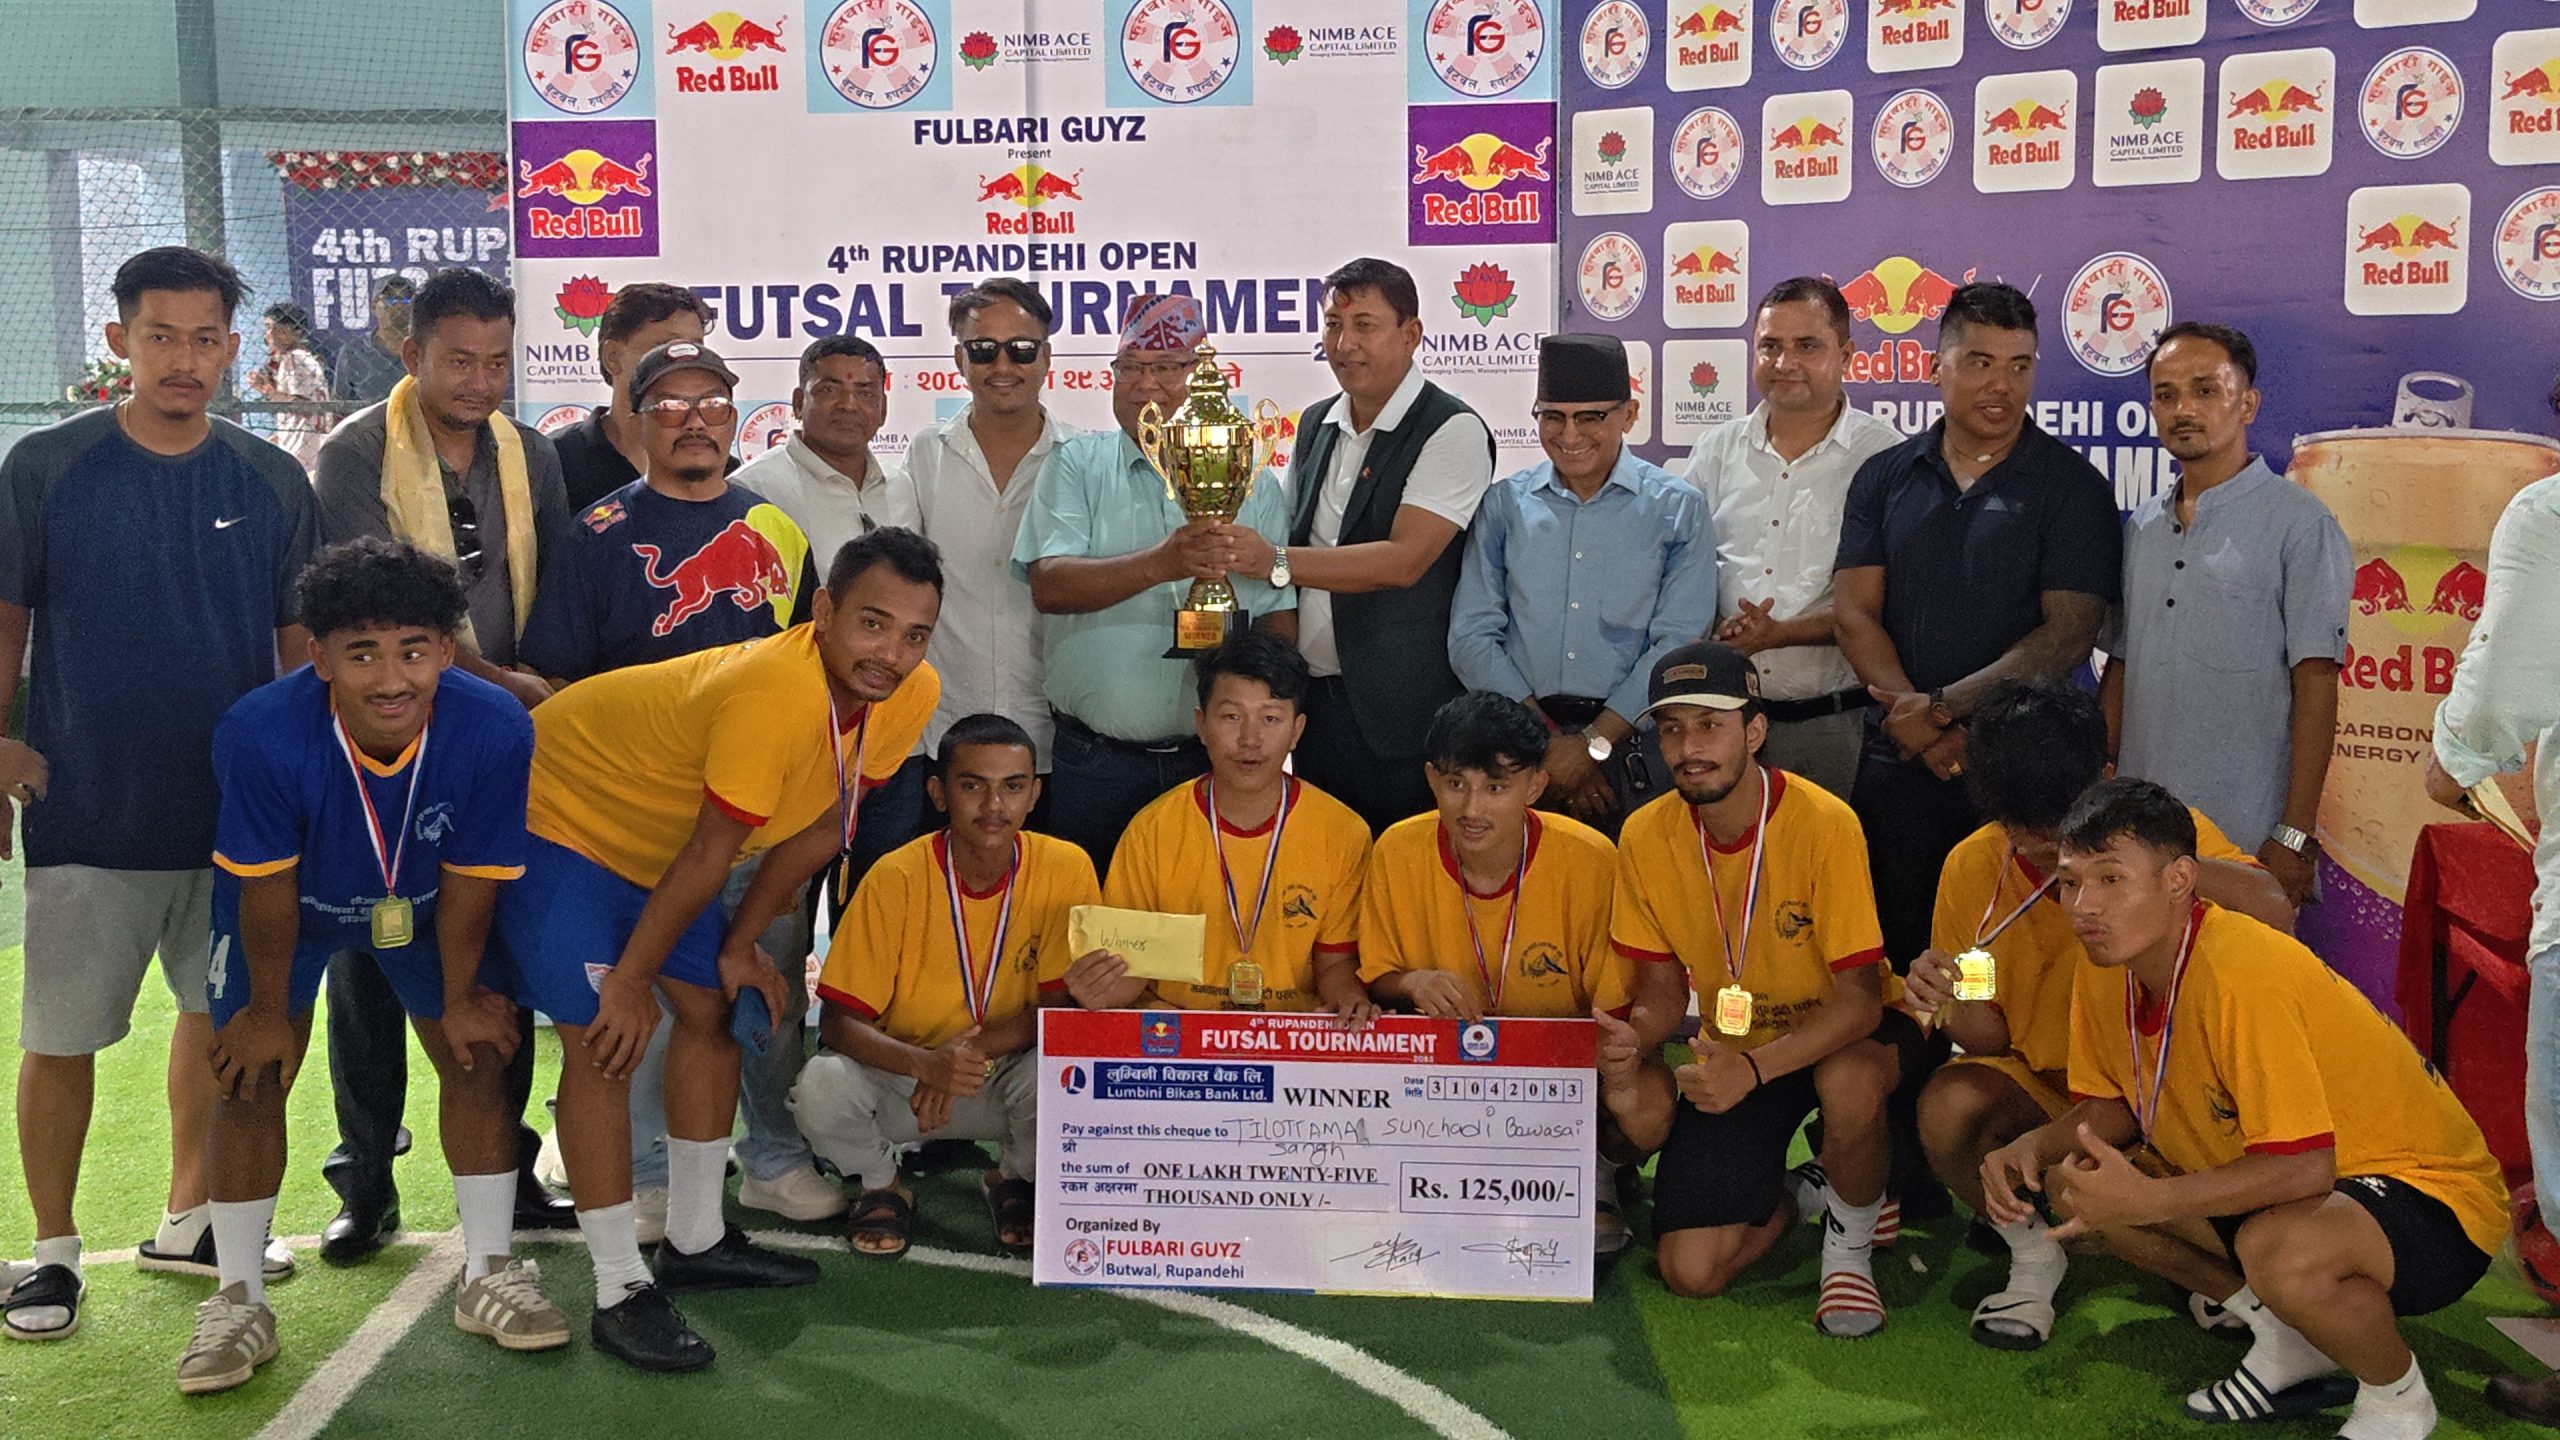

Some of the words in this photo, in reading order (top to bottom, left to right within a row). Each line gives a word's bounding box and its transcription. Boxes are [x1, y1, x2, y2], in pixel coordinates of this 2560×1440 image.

[2113, 1, 2149, 22] Red
[2153, 0, 2190, 19] Bull
[1004, 34, 1050, 46] NIMB
[1054, 33, 1091, 45] ACE
[1309, 28, 1355, 40] NIMB
[1359, 27, 1397, 40] ACE
[1882, 23, 1913, 45] Red
[1916, 21, 1949, 43] Bull
[1678, 45, 1707, 66] Red
[1710, 42, 1739, 63] Bull
[676, 66, 725, 92] Red
[729, 65, 779, 92] Bull
[914, 117, 1048, 145] FULBARI
[1061, 115, 1146, 142] GUYZ
[2509, 109, 2552, 134] Red
[2110, 134, 2148, 148] NIMB
[2152, 132, 2183, 144] ACE
[2234, 126, 2272, 150] Red
[2276, 124, 2316, 148] Bull
[1007, 148, 1051, 159] Present
[1988, 143, 2022, 165] Red
[2025, 141, 2060, 163] Bull
[2110, 148, 2146, 157] CAPITAL
[2148, 146, 2183, 155] LIMITED
[1584, 169, 1613, 182] NIMB
[1616, 168, 1639, 180] ACE
[1774, 158, 1805, 179] Red
[1807, 156, 1839, 177] Bull
[1424, 193, 1480, 225] Red
[1482, 191, 1540, 225] Bull
[529, 207, 585, 239] Red
[587, 206, 643, 239] Bull
[986, 212, 1028, 234] Red
[1032, 211, 1074, 234] Bull
[312, 228, 391, 263] 4th
[406, 227, 510, 262] RUP
[828, 244, 869, 274] 4th
[882, 242, 1085, 273] RUPANDEHI
[1101, 241, 1197, 271] OPEN
[2363, 263, 2403, 285] Red
[2407, 261, 2449, 284] Bull
[1675, 284, 1704, 304] Red
[1706, 283, 1735, 304] Bull
[1422, 334, 1488, 352] NIMB
[526, 345, 591, 362] NIMB
[1423, 355, 1484, 366] CAPITAL
[1488, 354, 1540, 365] LIMITE
[527, 365, 587, 376] CAPITAL
[917, 371, 967, 391] २०८
[1675, 402, 1705, 412] NIMB
[1707, 401, 1733, 412] ACE
[1494, 428, 1527, 437] NIMB
[1267, 451, 1289, 467] Re
[2331, 743, 2420, 763] NERGY
[1100, 928, 1148, 951] Winner
[1268, 1018, 1336, 1030] RUPANDEH
[1202, 1029, 1281, 1050] FUTSAL
[1288, 1031, 1437, 1053] TOURNAMENT
[1162, 1066, 1208, 1082] विकास
[1404, 1076, 1424, 1085] Date
[1107, 1086, 1162, 1098] Lumbini
[1165, 1087, 1201, 1099] Bikas
[1205, 1088, 1239, 1100] Bank
[1243, 1089, 1268, 1101] Ltd.
[1283, 1086, 1392, 1109] WINNER
[1062, 1123, 1084, 1136] Pay
[1087, 1123, 1133, 1138] against
[1137, 1123, 1160, 1136] this
[1164, 1125, 1212, 1139] cheque
[1215, 1126, 1228, 1137] to
[1062, 1138, 1077, 1153] श्री
[1061, 1162, 1083, 1173] the
[1085, 1165, 1113, 1173] sum
[1116, 1162, 1130, 1174] of
[1144, 1163, 1183, 1178] ONE
[1188, 1163, 1241, 1180] LAKH
[1248, 1165, 1377, 1183] TWENTY-FIVE
[1061, 1182, 1088, 1193] रकम
[1409, 1176, 1448, 1200] Rs.
[1458, 1178, 1575, 1207] 125,000/-
[1143, 1189, 1254, 1205] THOUSAND
[1259, 1191, 1314, 1208] ONLY
[1066, 1217, 1138, 1233] Organized
[1143, 1220, 1160, 1235] By
[1106, 1239, 1184, 1256] FULBARI
[1191, 1242, 1241, 1258] GUYZ
[1106, 1263, 1161, 1279] Butwal,
[1165, 1264, 1244, 1279] Rupandehi
